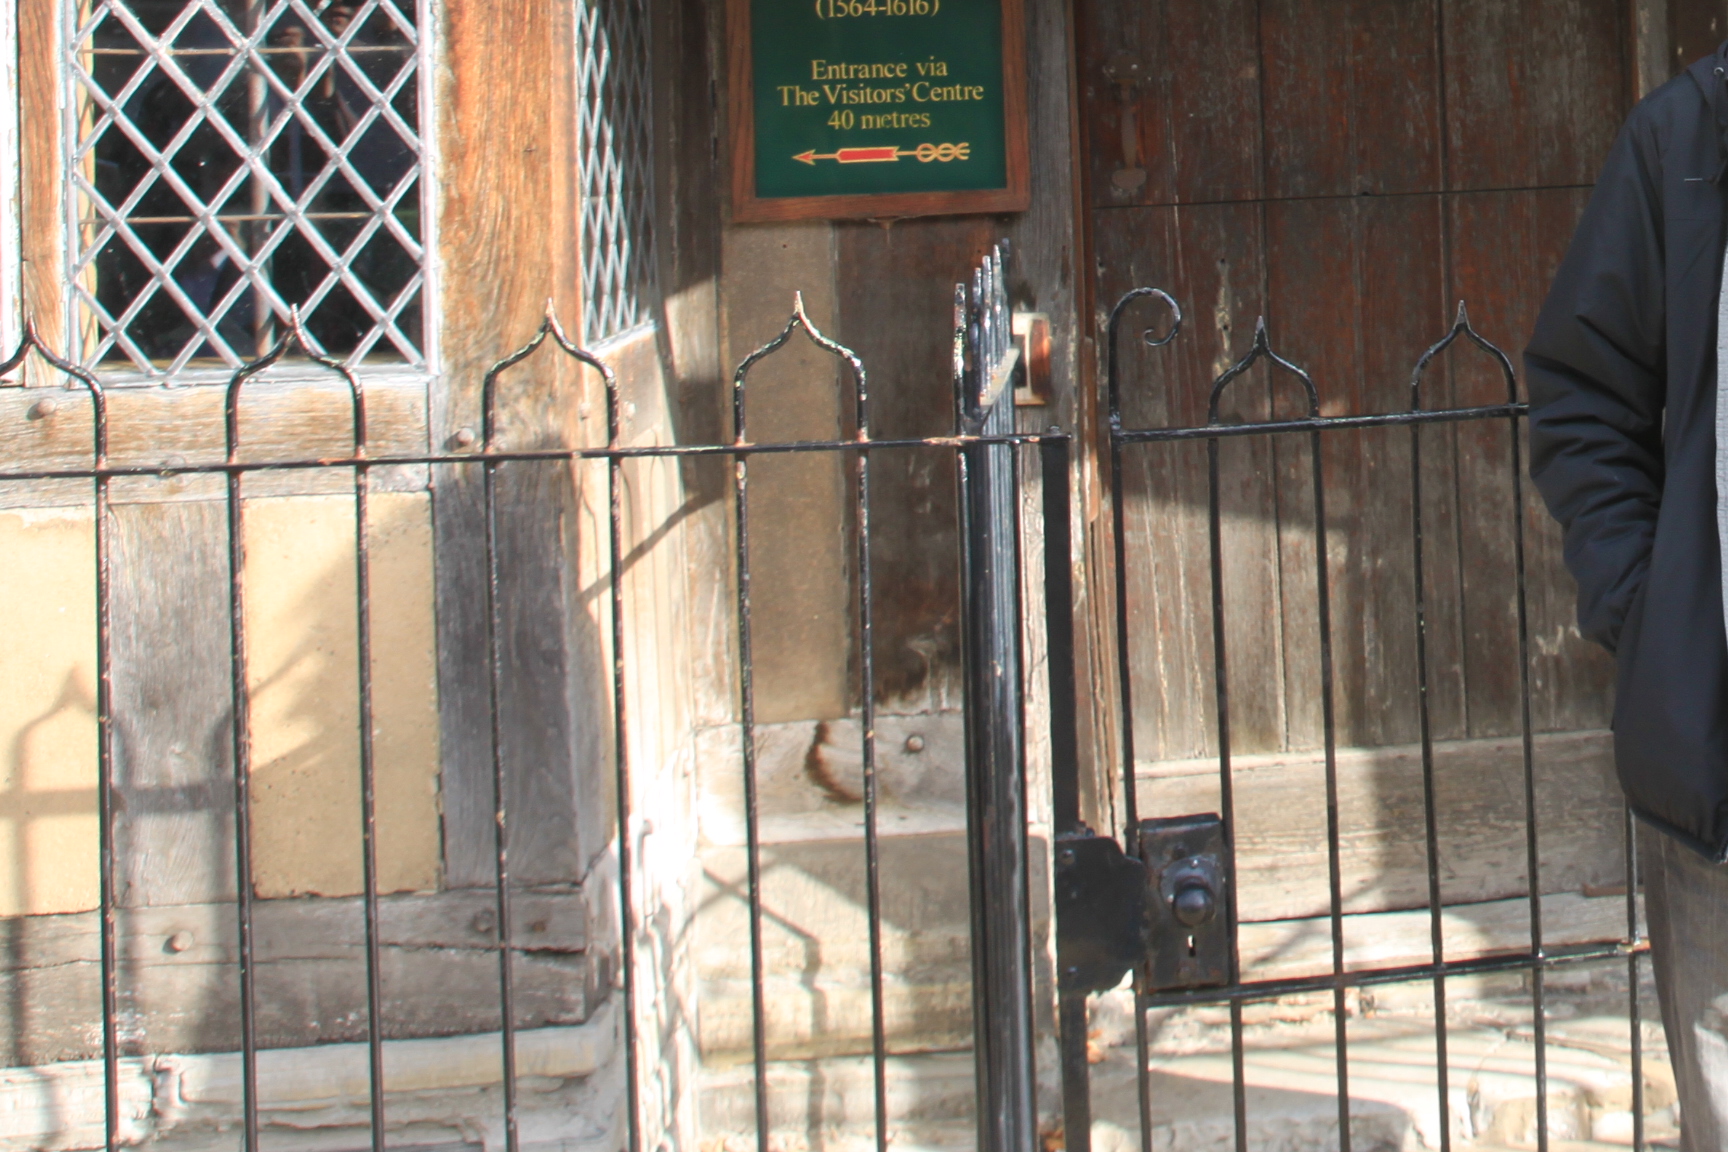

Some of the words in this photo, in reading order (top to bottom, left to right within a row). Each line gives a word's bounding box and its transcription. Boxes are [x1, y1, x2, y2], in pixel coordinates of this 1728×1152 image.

[811, 59, 908, 80] Entrance
[915, 56, 948, 77] via
[777, 85, 820, 106] The
[911, 81, 984, 103] Centre
[827, 110, 855, 130] 40
[860, 111, 931, 129] metres
